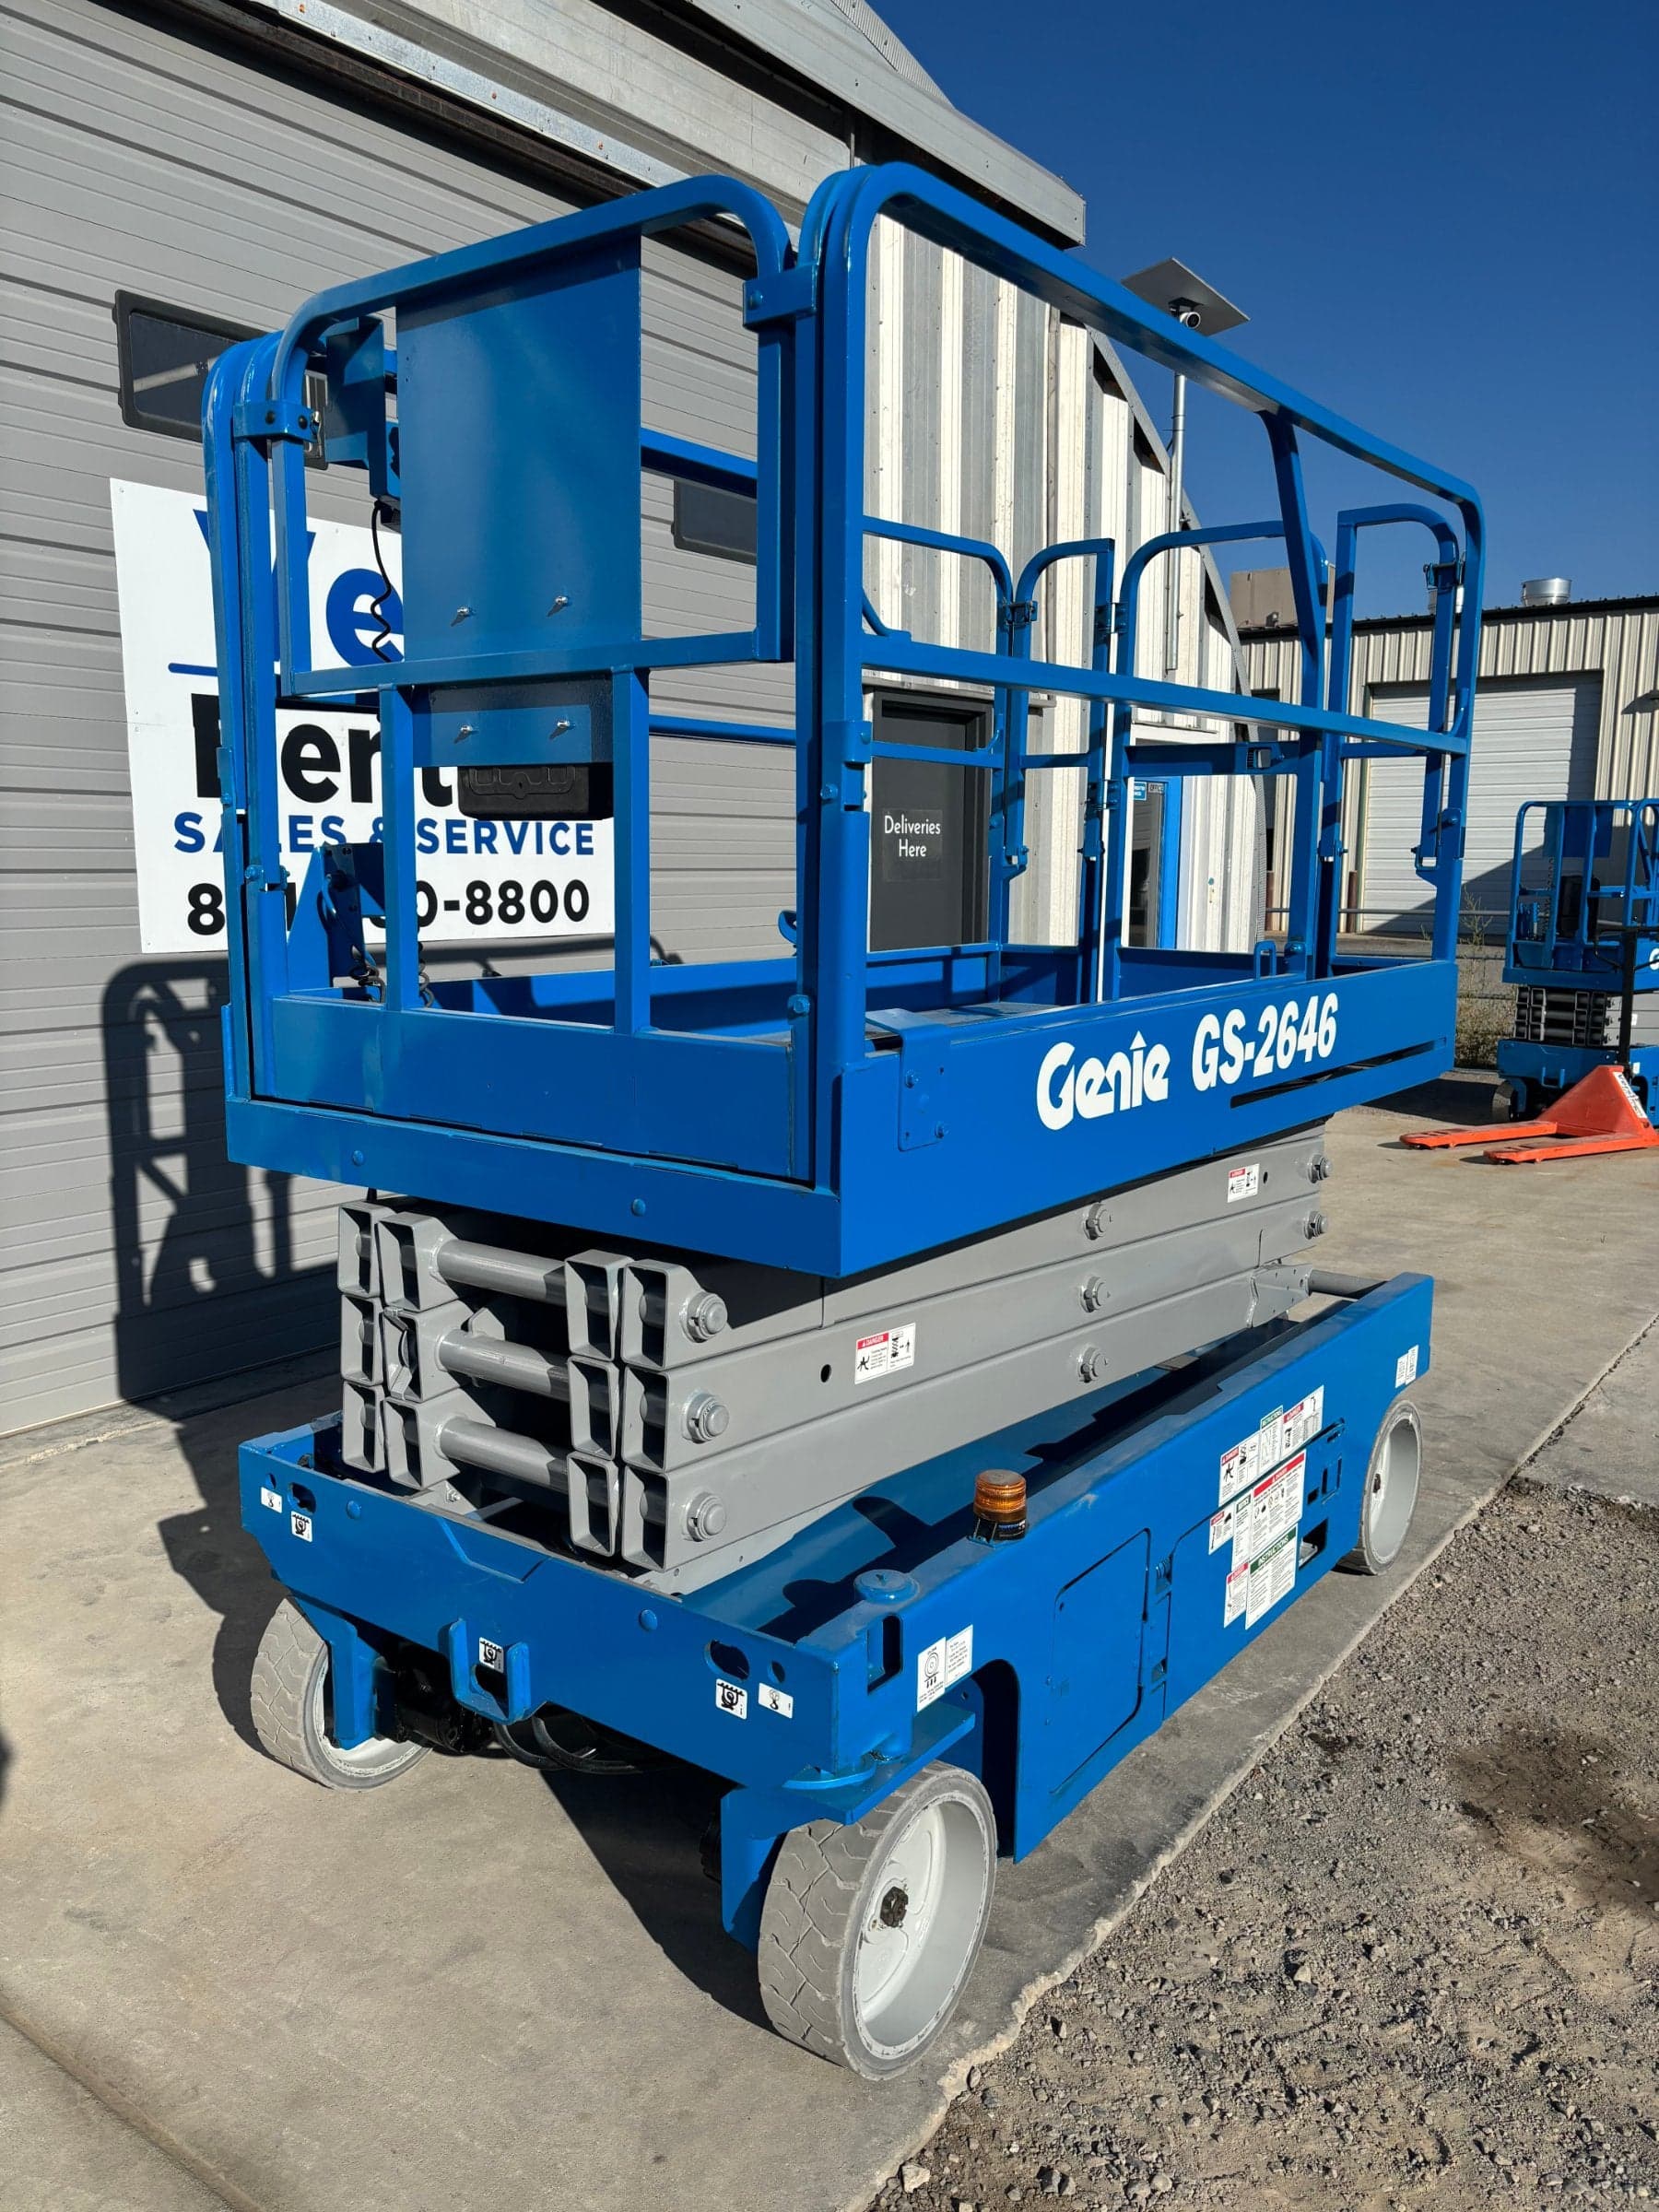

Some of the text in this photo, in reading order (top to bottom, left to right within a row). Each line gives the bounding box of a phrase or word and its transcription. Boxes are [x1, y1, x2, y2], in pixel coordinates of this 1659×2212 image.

[174, 812, 347, 853] SES
[417, 818, 594, 855] SERVICE
[885, 813, 941, 834] Deliveries
[899, 838, 927, 857] Here
[1036, 993, 1338, 1131] Genie GS-2646
